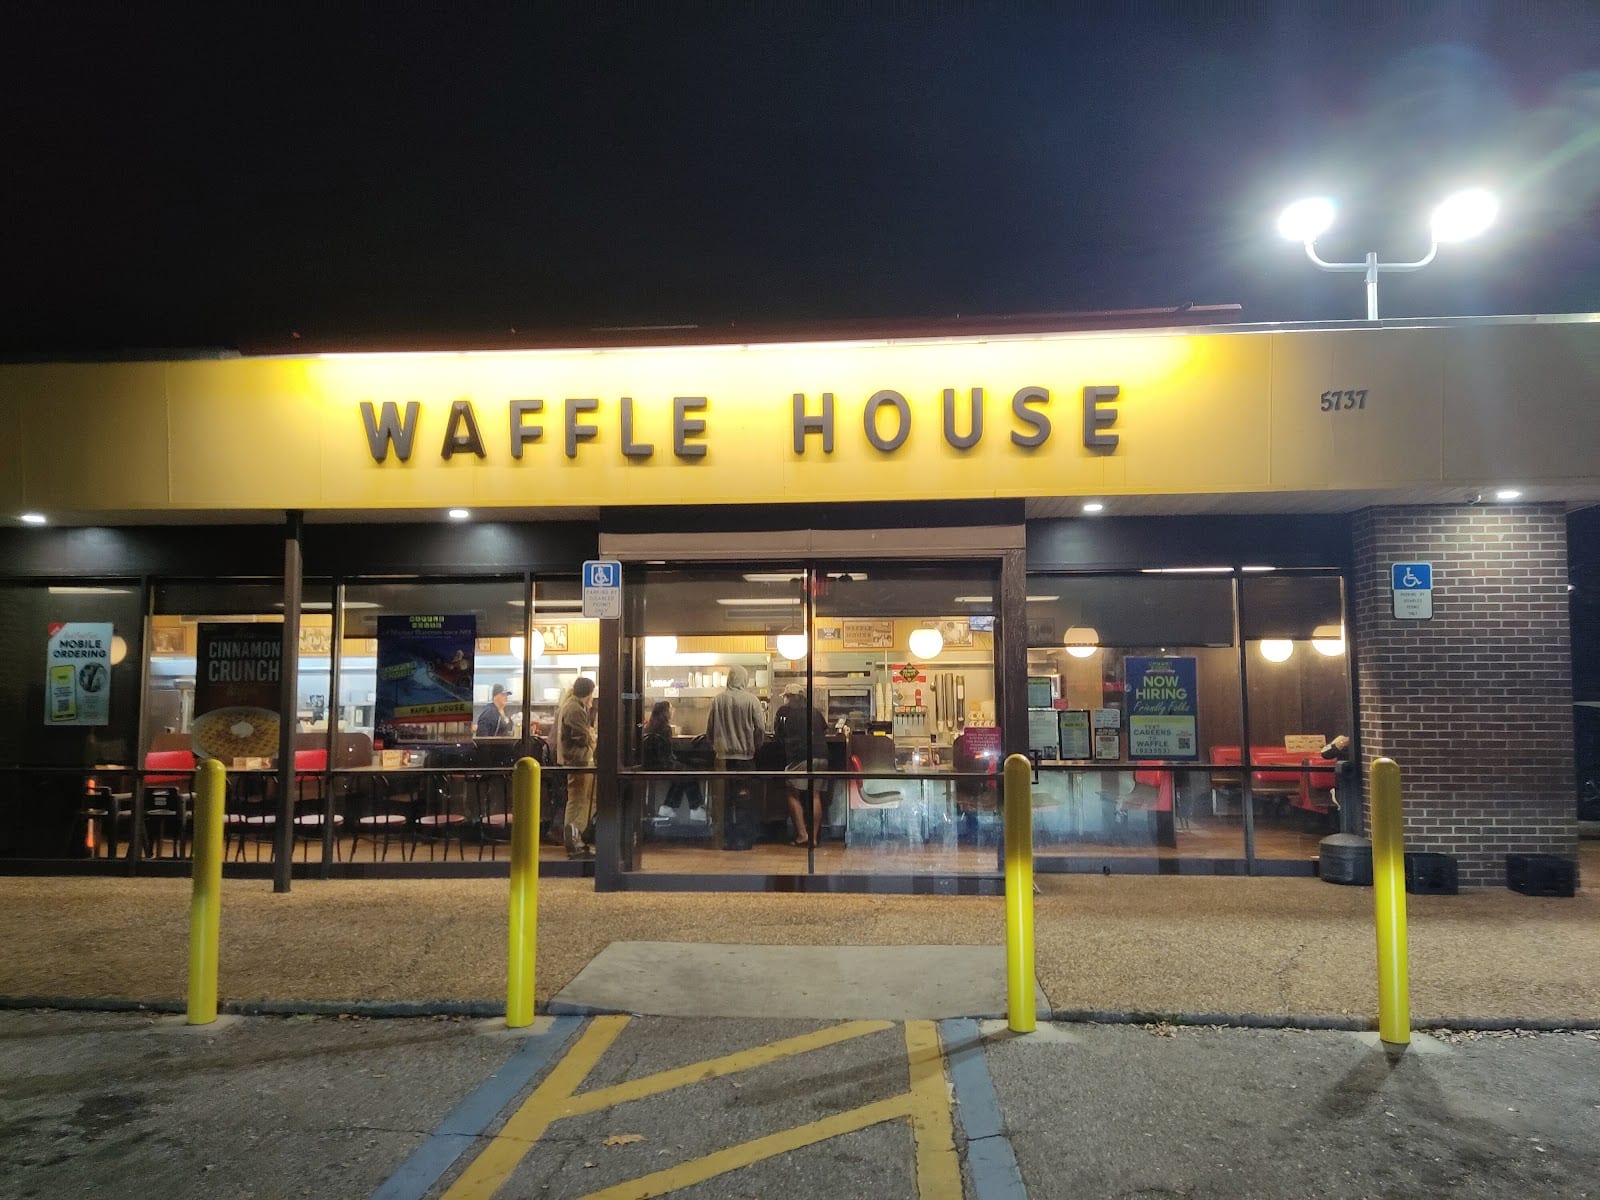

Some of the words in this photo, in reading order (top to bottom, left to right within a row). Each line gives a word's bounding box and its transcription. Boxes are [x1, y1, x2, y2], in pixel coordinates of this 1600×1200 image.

[1320, 389, 1369, 412] 5737
[359, 396, 708, 463] WAFFLE
[793, 385, 1120, 456] HOUSE
[59, 640, 103, 648] MOBILE
[208, 641, 281, 658] CINNAMON
[53, 650, 107, 658] ORDERING
[208, 660, 280, 682] CRUNCH
[1143, 676, 1179, 688] NOW
[1136, 688, 1188, 700] HIRING
[438, 704, 465, 712] HOUSE
[1133, 701, 1166, 716] Friendly
